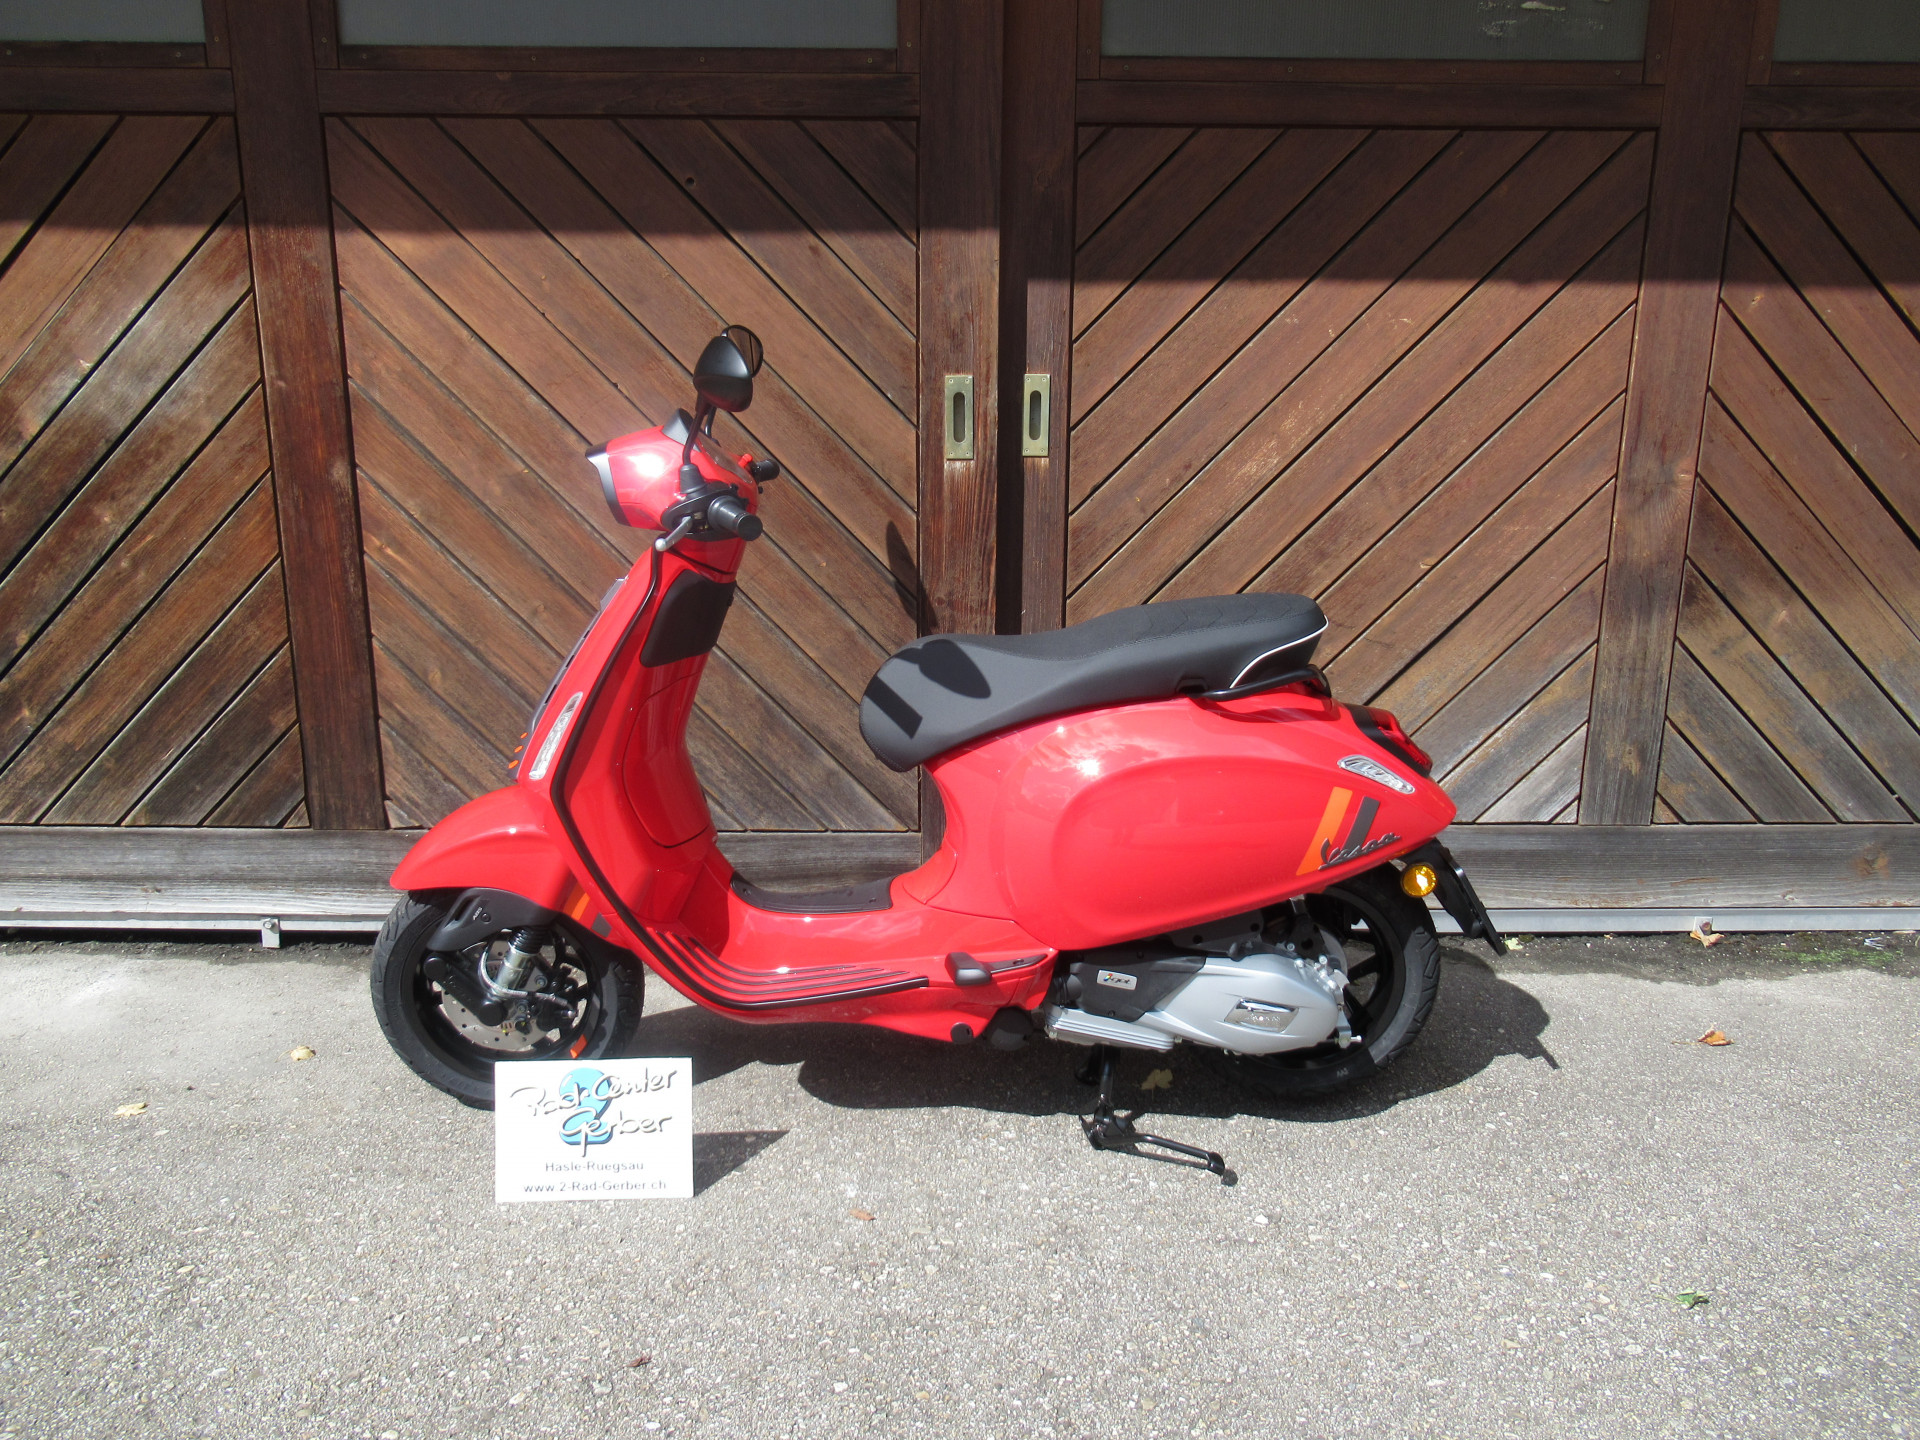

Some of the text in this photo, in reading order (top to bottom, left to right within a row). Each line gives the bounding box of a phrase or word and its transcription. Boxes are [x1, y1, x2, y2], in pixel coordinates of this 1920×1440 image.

[1317, 832, 1401, 870] Vespa
[561, 1107, 673, 1158] Gerber
[545, 1161, 645, 1174] Hasle-Ruegsau
